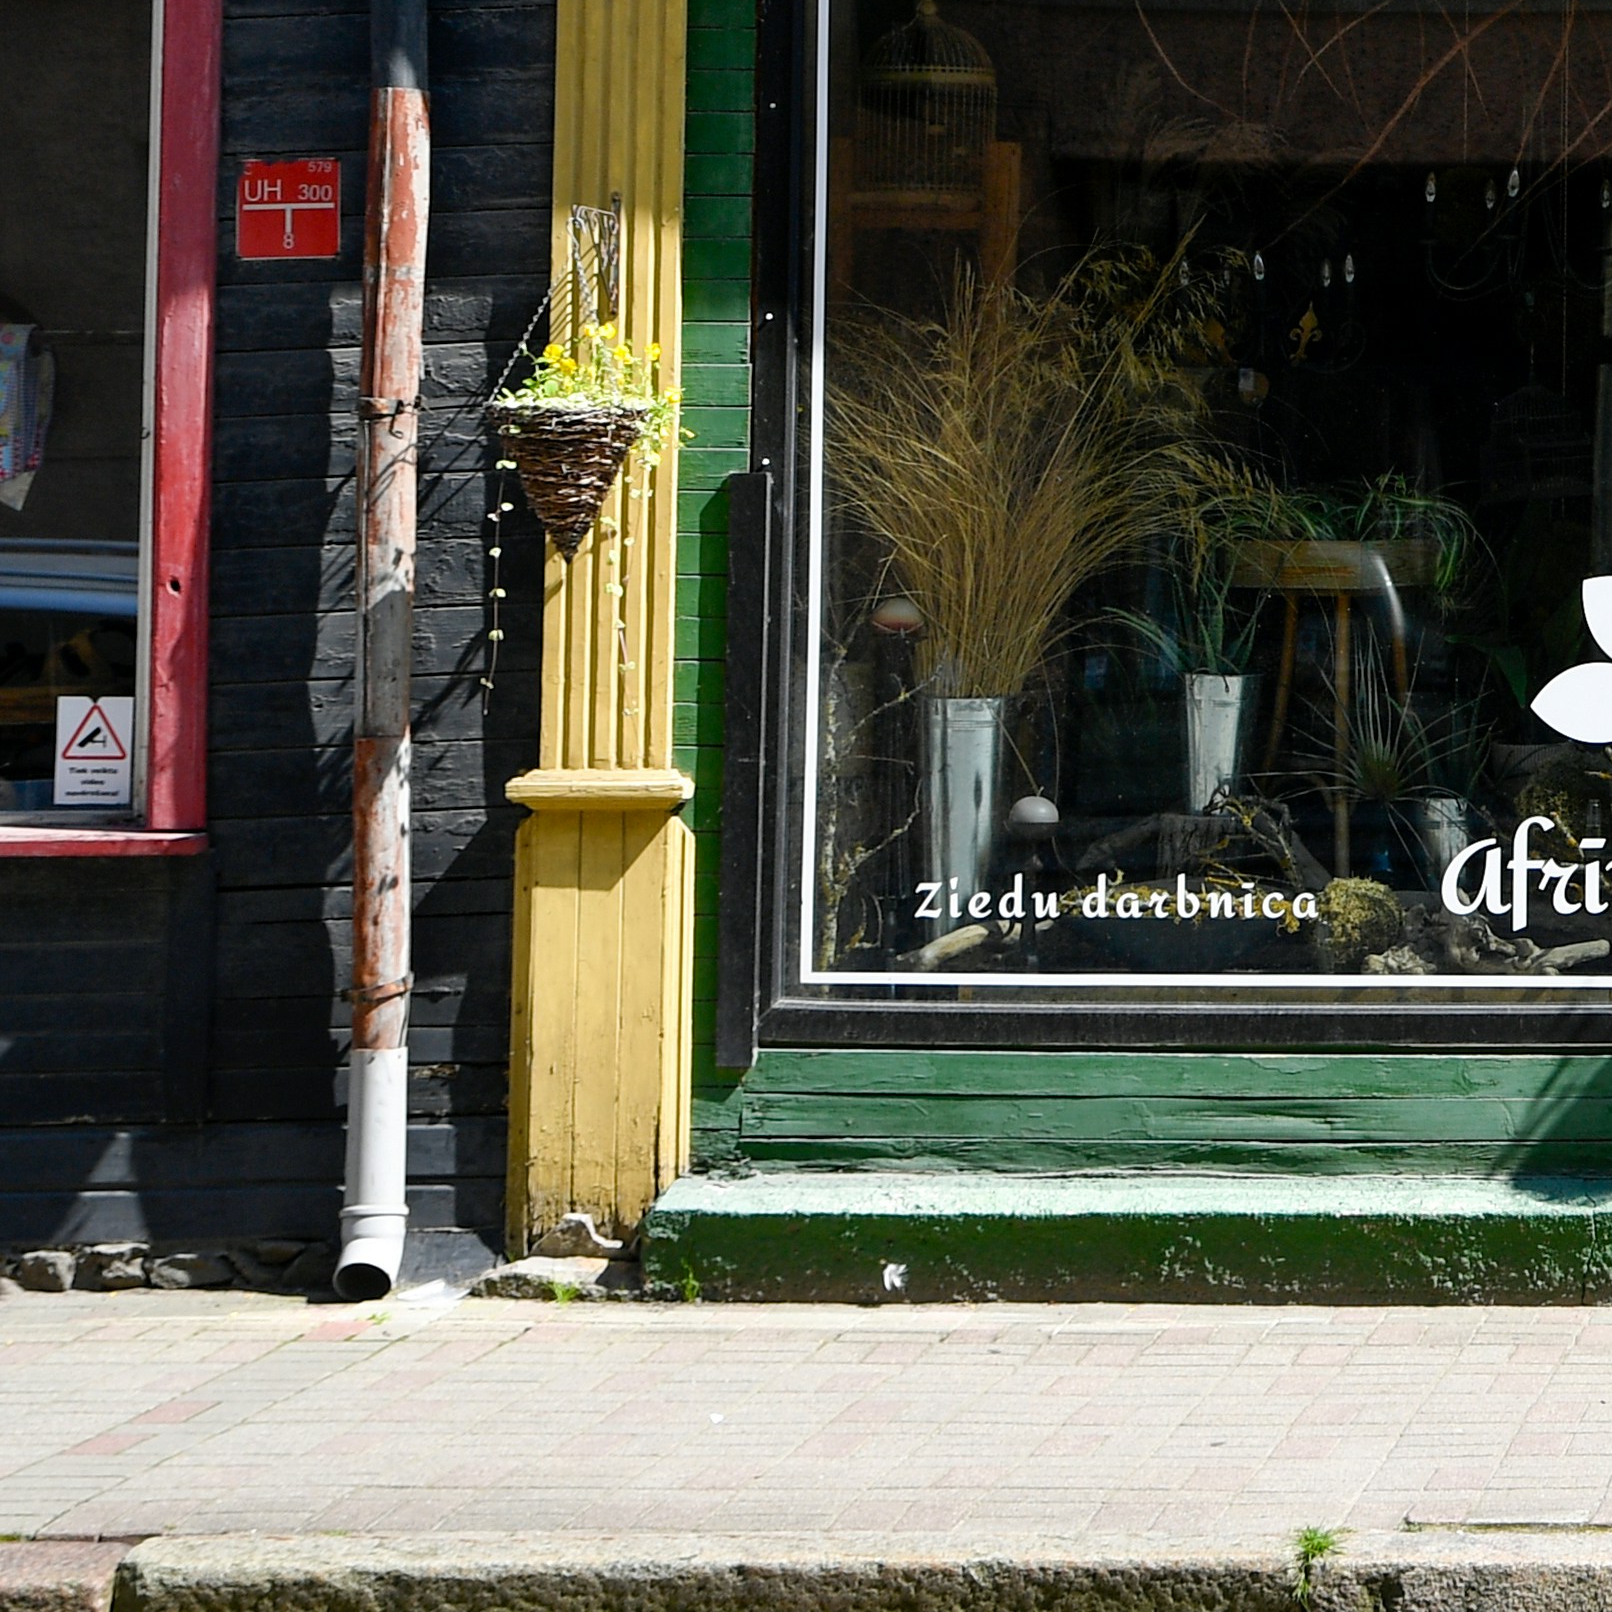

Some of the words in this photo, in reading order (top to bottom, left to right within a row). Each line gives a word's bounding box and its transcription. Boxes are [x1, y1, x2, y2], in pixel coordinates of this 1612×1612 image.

[309, 161, 332, 172] 579
[244, 179, 282, 201] UH
[298, 184, 333, 201] 300
[283, 233, 294, 249] 8
[914, 872, 1062, 919] Ziedu
[1082, 872, 1320, 919] darbnīca
